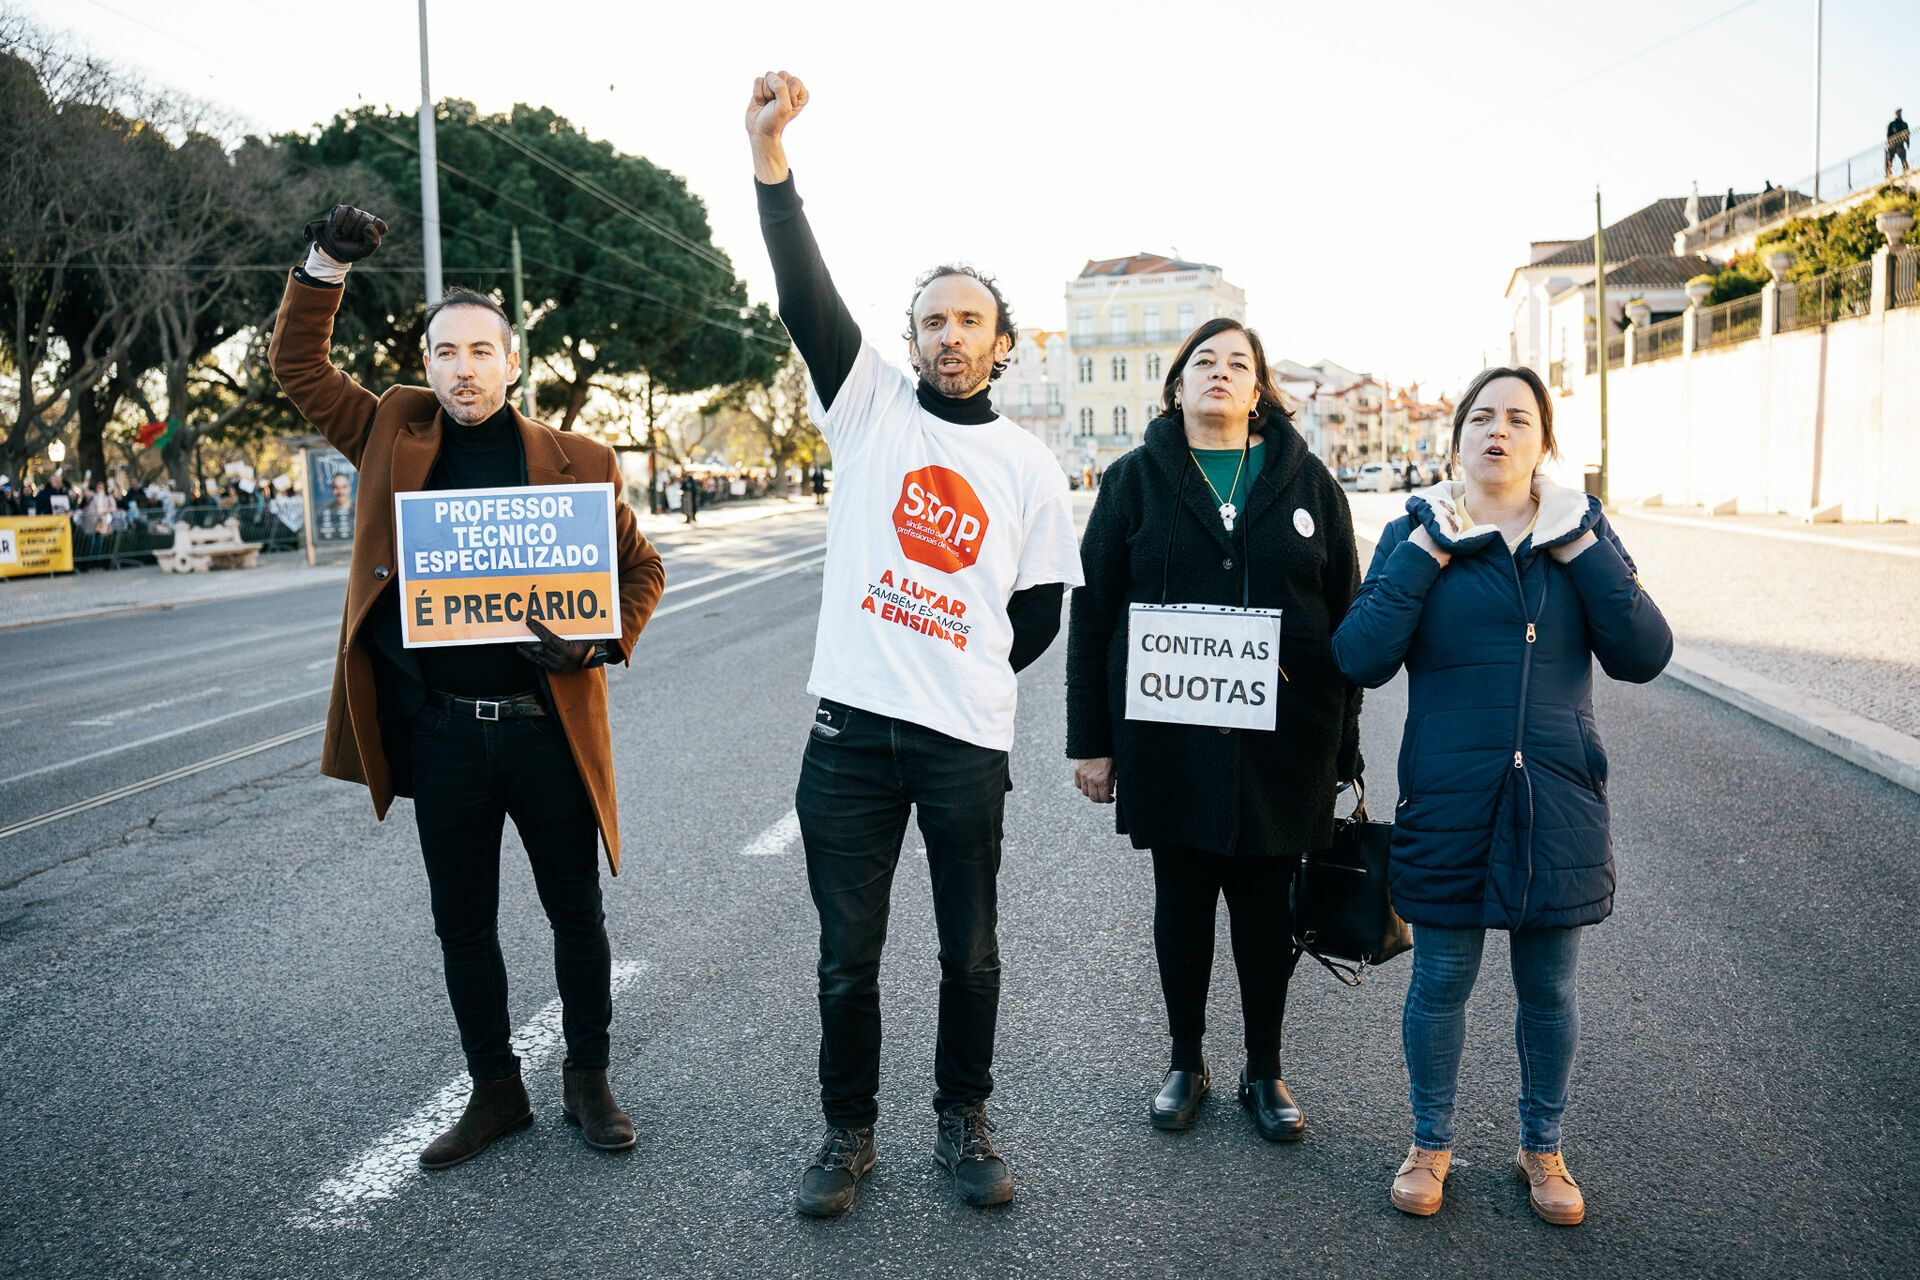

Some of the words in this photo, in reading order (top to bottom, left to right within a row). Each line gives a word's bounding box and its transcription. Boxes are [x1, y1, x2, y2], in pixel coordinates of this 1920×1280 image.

[434, 496, 575, 524] PROFESSOR
[452, 520, 557, 549] TÉCNICO
[896, 526, 938, 546] profissionais
[905, 519, 935, 536] sindicato
[414, 543, 599, 574] ESPECIALIZADO
[415, 589, 434, 627] É
[443, 584, 607, 625] PRECÁRIO.
[867, 583, 917, 612] TAMBÉM
[918, 605, 971, 635] ESAMOS
[879, 569, 894, 588] A
[900, 578, 967, 619] LUTAR
[861, 595, 876, 614] A
[880, 602, 968, 652] ENSINAR
[1141, 633, 1234, 658] CONTRA
[1239, 640, 1269, 661] AS
[1139, 672, 1267, 706] QUOTAS
